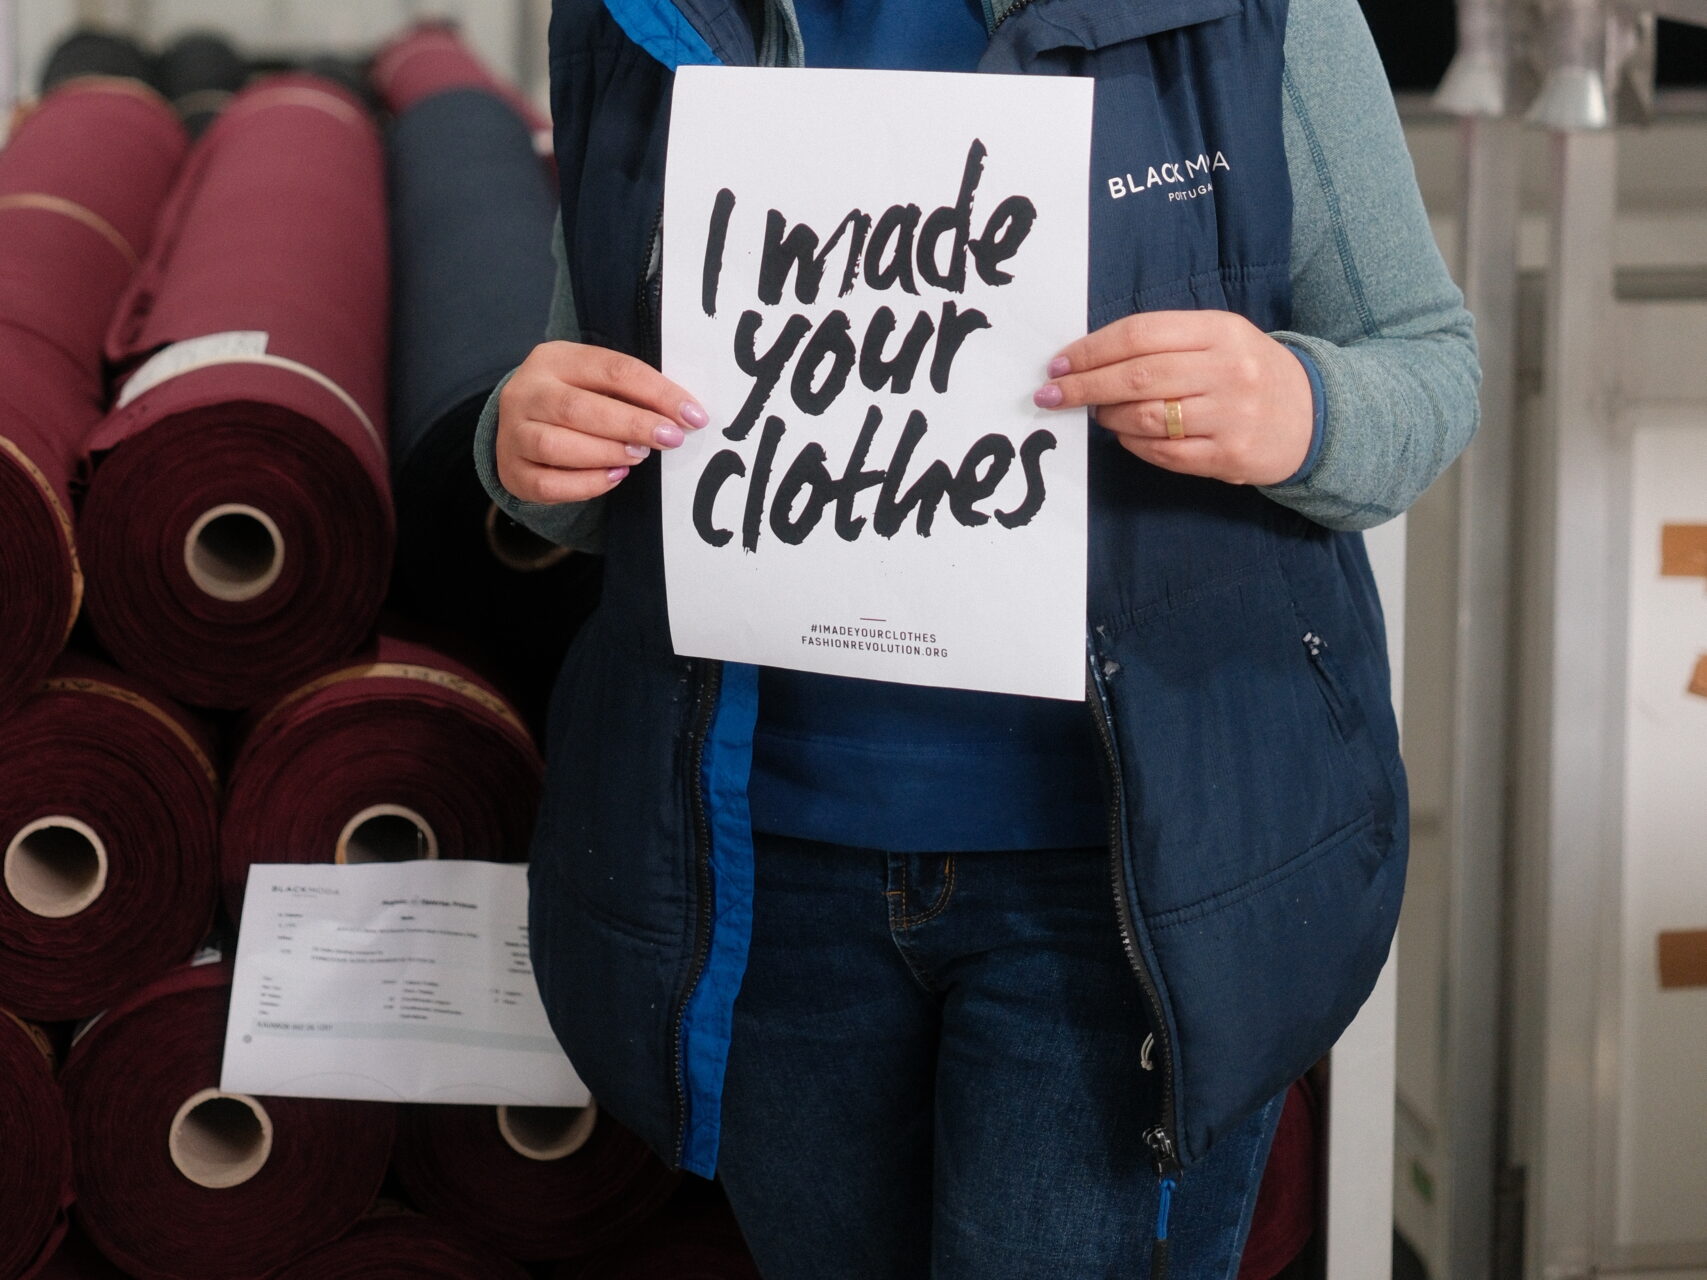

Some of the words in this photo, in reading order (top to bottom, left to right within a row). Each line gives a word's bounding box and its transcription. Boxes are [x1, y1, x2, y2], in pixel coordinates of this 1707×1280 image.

[1107, 151, 1231, 200] BLACKMA
[702, 188, 736, 318] I
[757, 138, 1037, 306] made
[722, 300, 992, 442] your
[692, 405, 1058, 555] clothes
[801, 635, 949, 658] FASHIONREVOLUTION.ORG
[810, 623, 938, 644] #IMADEYOURCLOTHES
